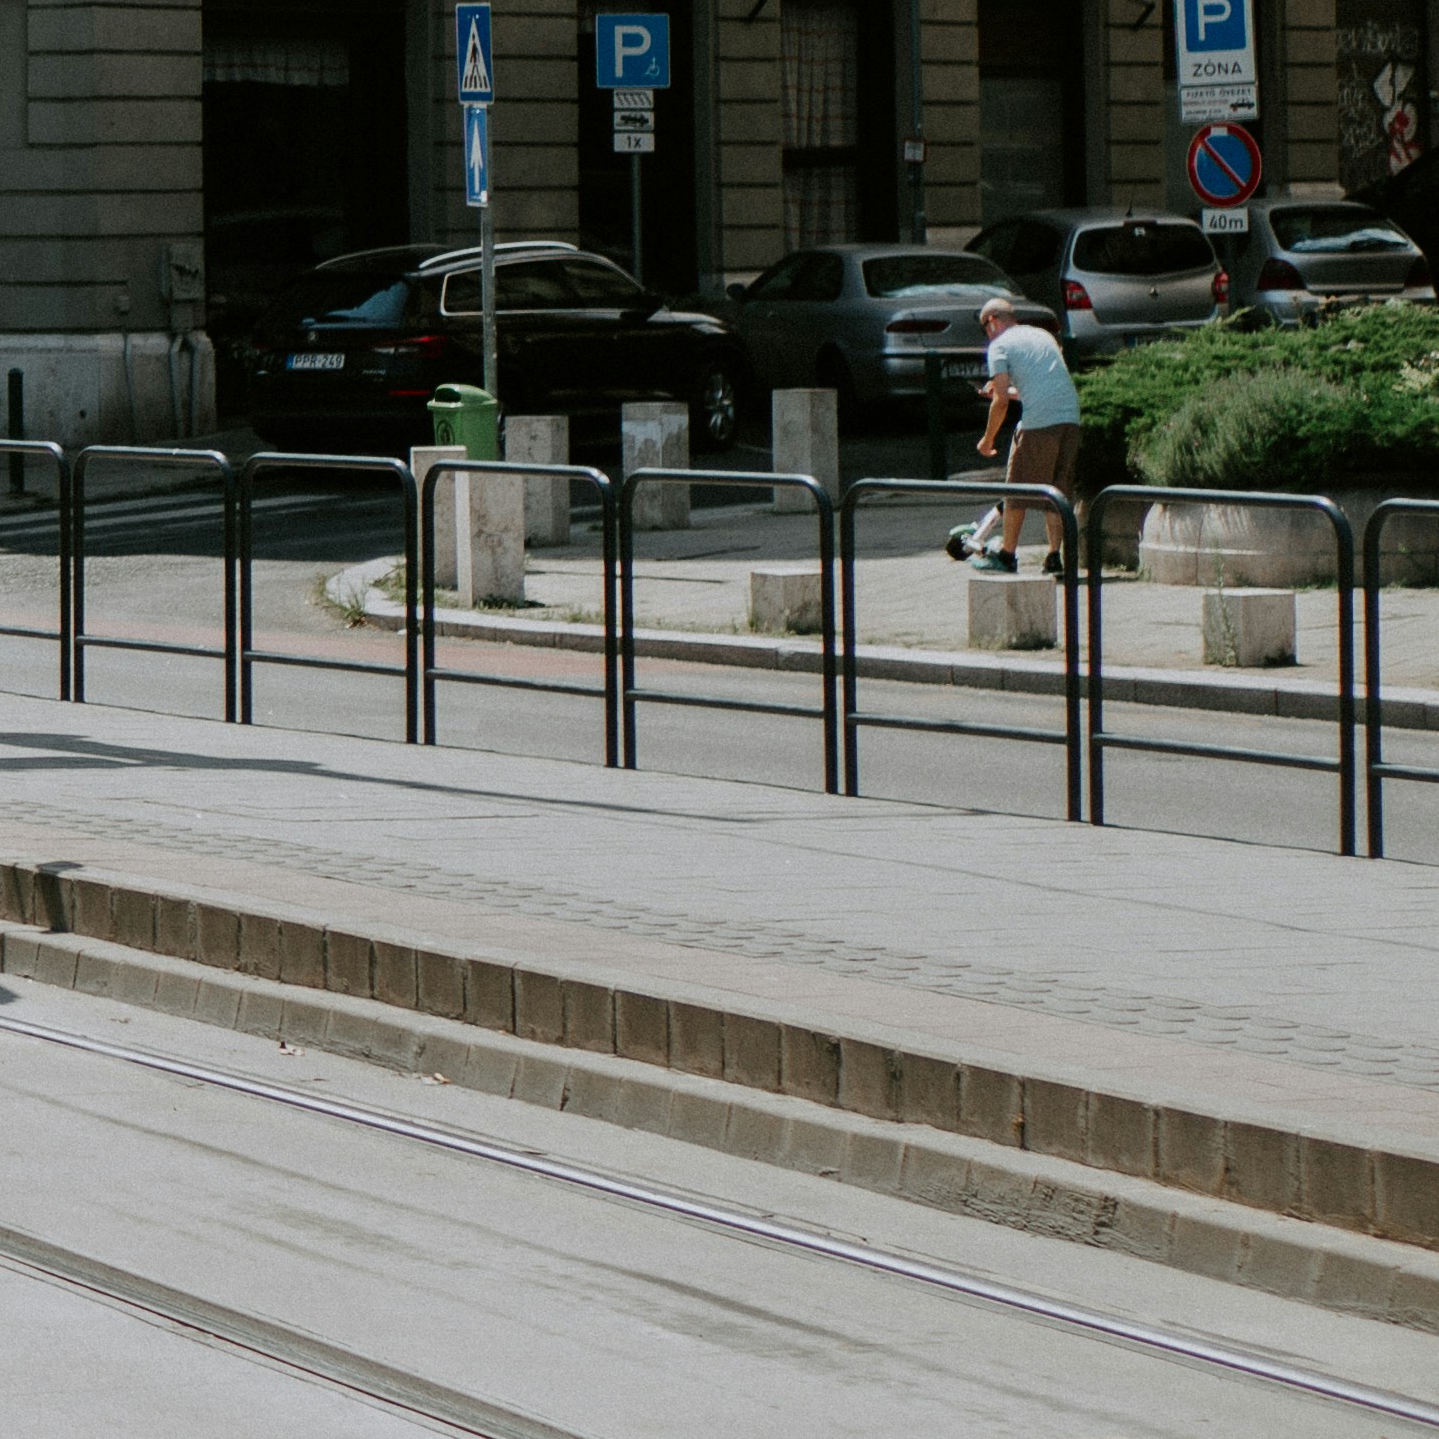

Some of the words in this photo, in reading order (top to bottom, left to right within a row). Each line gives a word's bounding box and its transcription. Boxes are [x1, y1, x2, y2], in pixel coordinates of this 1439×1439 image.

[614, 25, 651, 77] P
[1192, 60, 1242, 77] ZÓNA
[1209, 213, 1243, 230] 40m
